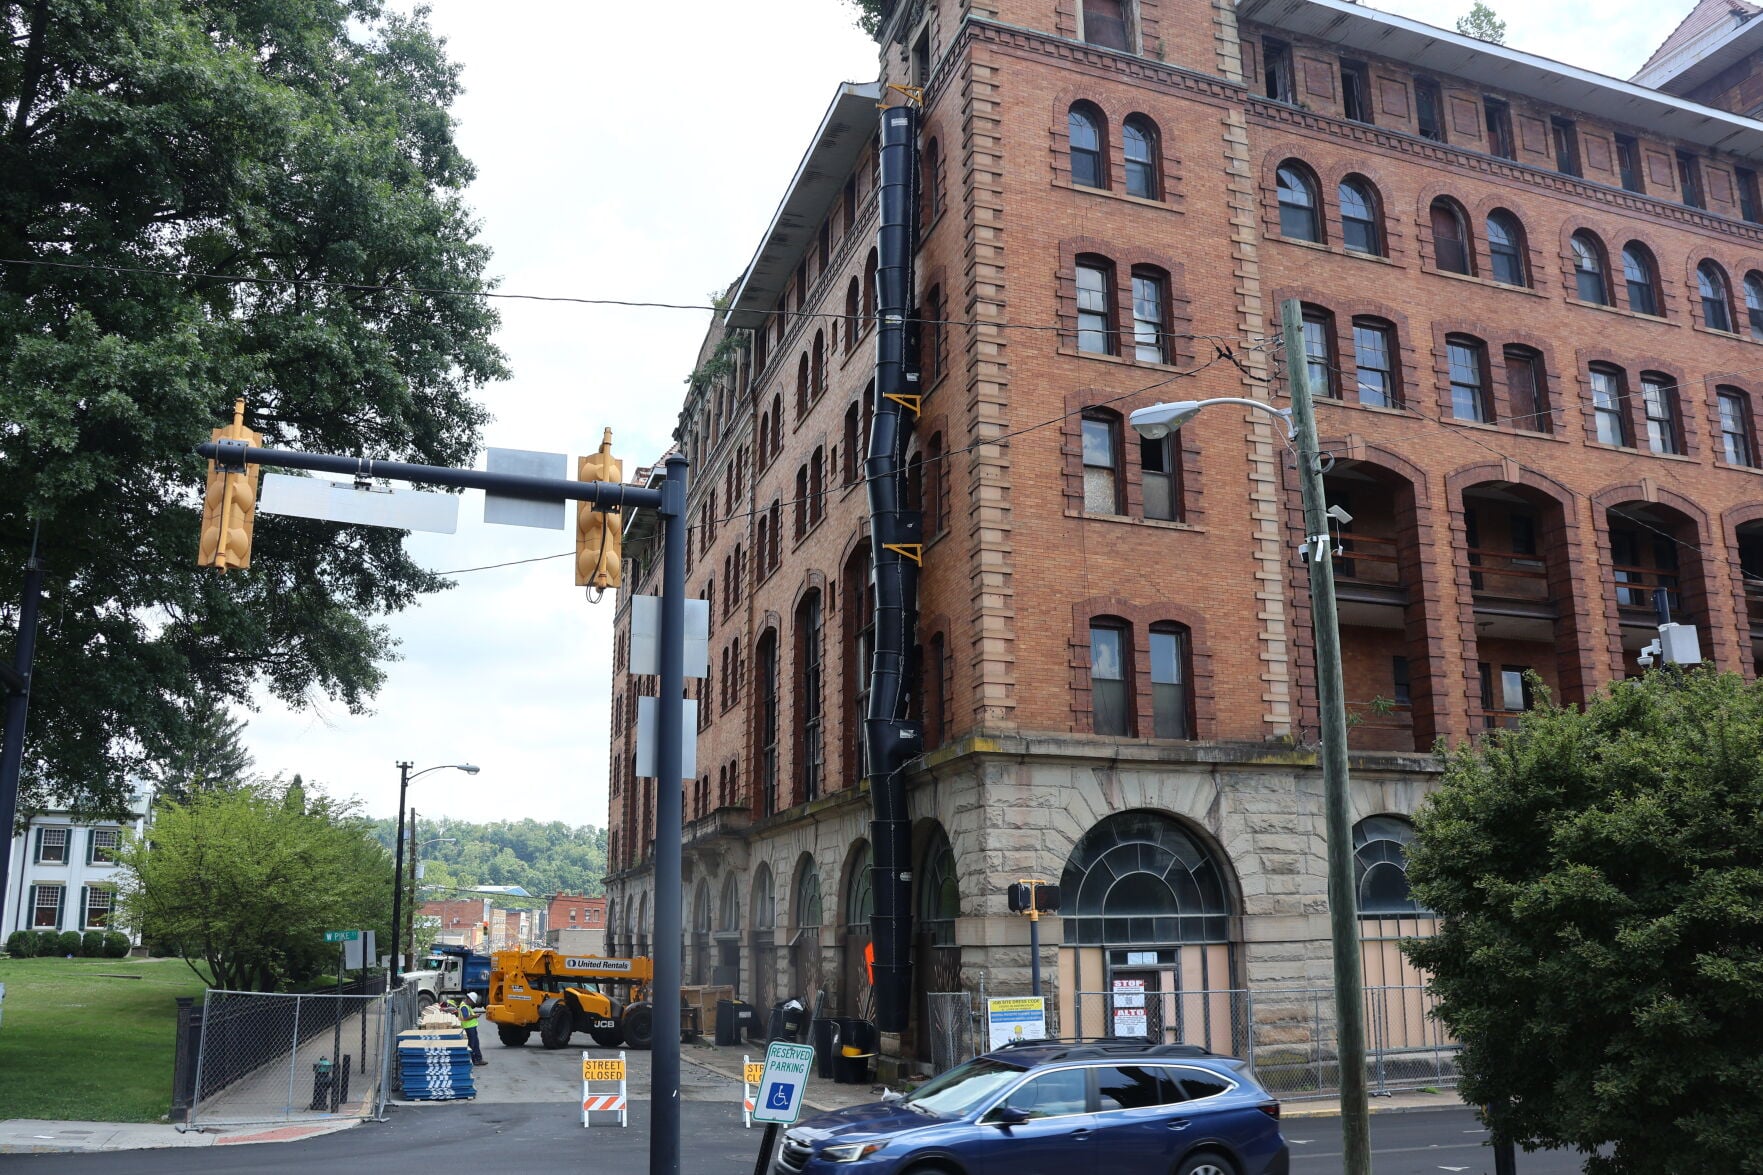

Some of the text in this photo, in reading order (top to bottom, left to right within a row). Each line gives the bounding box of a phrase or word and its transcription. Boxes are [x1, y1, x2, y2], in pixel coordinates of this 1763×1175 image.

[326, 933, 332, 941] W
[334, 931, 350, 940] PIKE
[577, 960, 628, 969] United Rentals
[594, 1020, 615, 1028] JCB
[771, 1047, 811, 1061] RESERVED
[586, 1060, 621, 1070] STREET
[770, 1061, 804, 1073] PARKING
[585, 1071, 622, 1080] CLOSED
